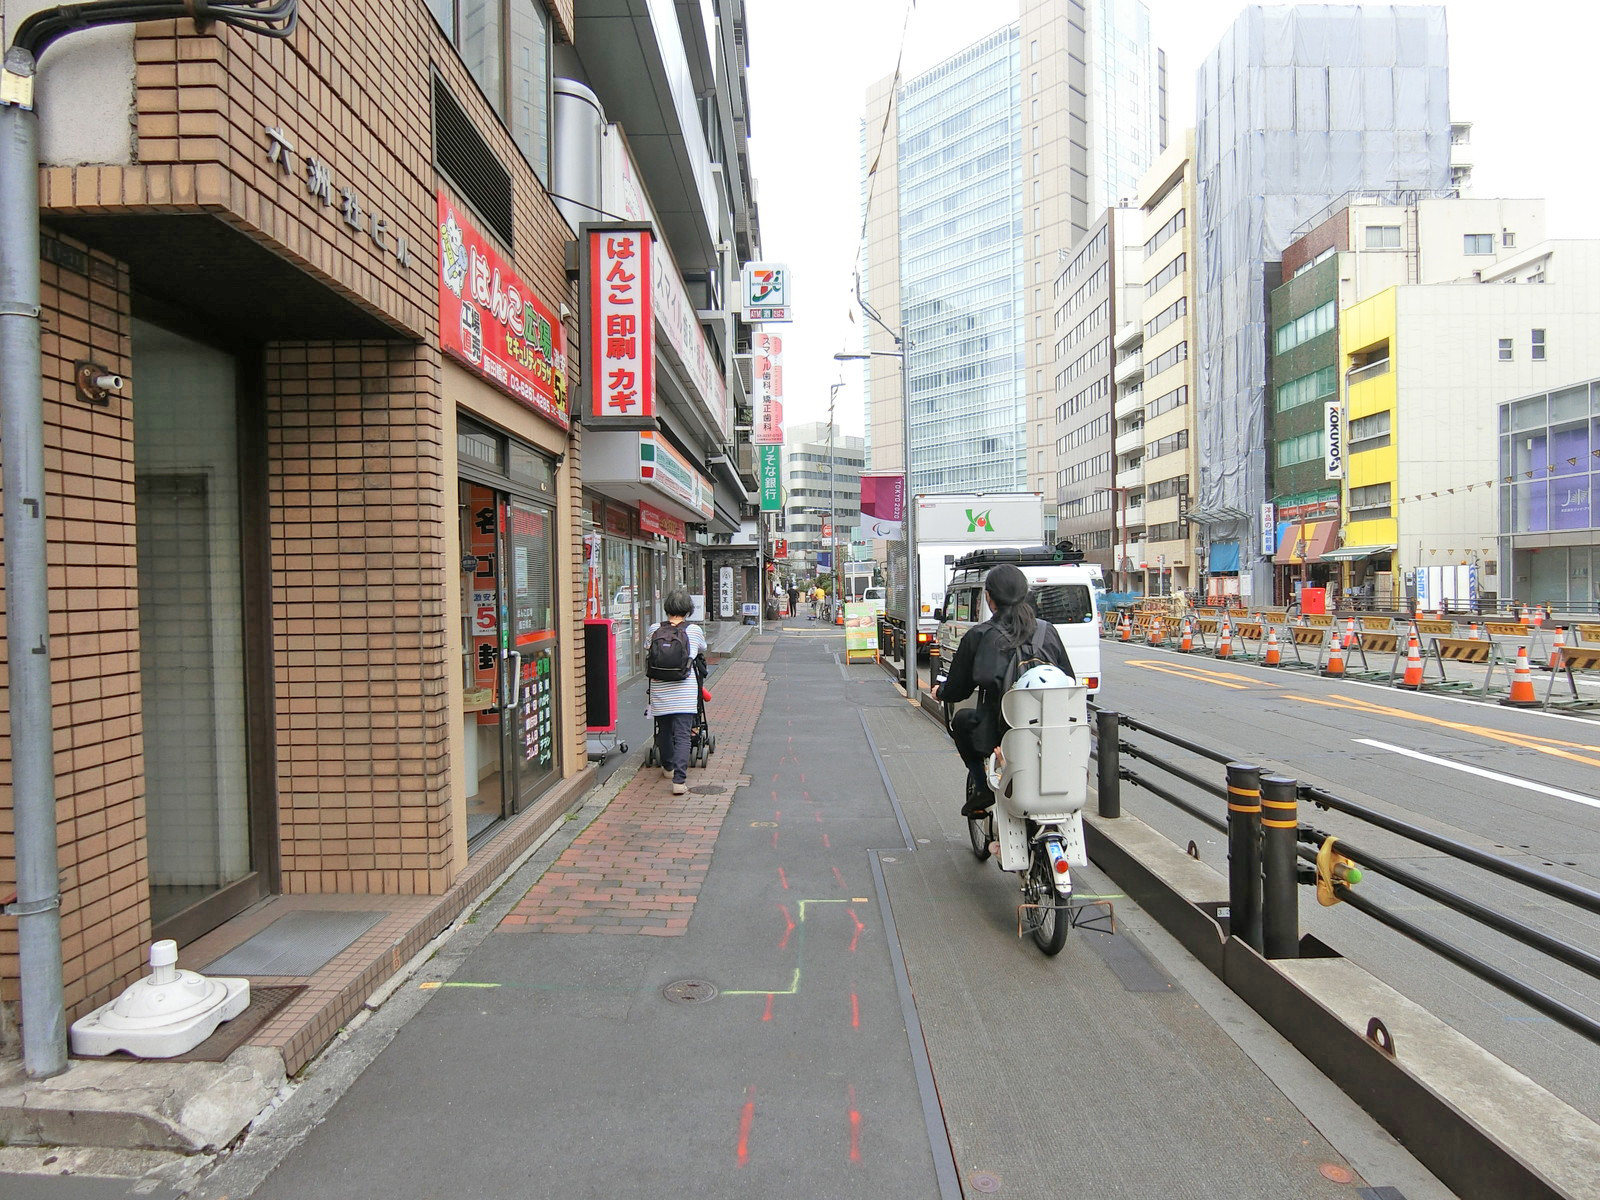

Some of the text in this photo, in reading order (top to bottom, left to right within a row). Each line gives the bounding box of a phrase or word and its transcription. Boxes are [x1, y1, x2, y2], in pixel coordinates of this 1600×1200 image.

[606, 237, 638, 413] はんこ 印刷 カギ
[1330, 407, 1340, 457] KOKUYO
[894, 481, 902, 502] TOKYO
